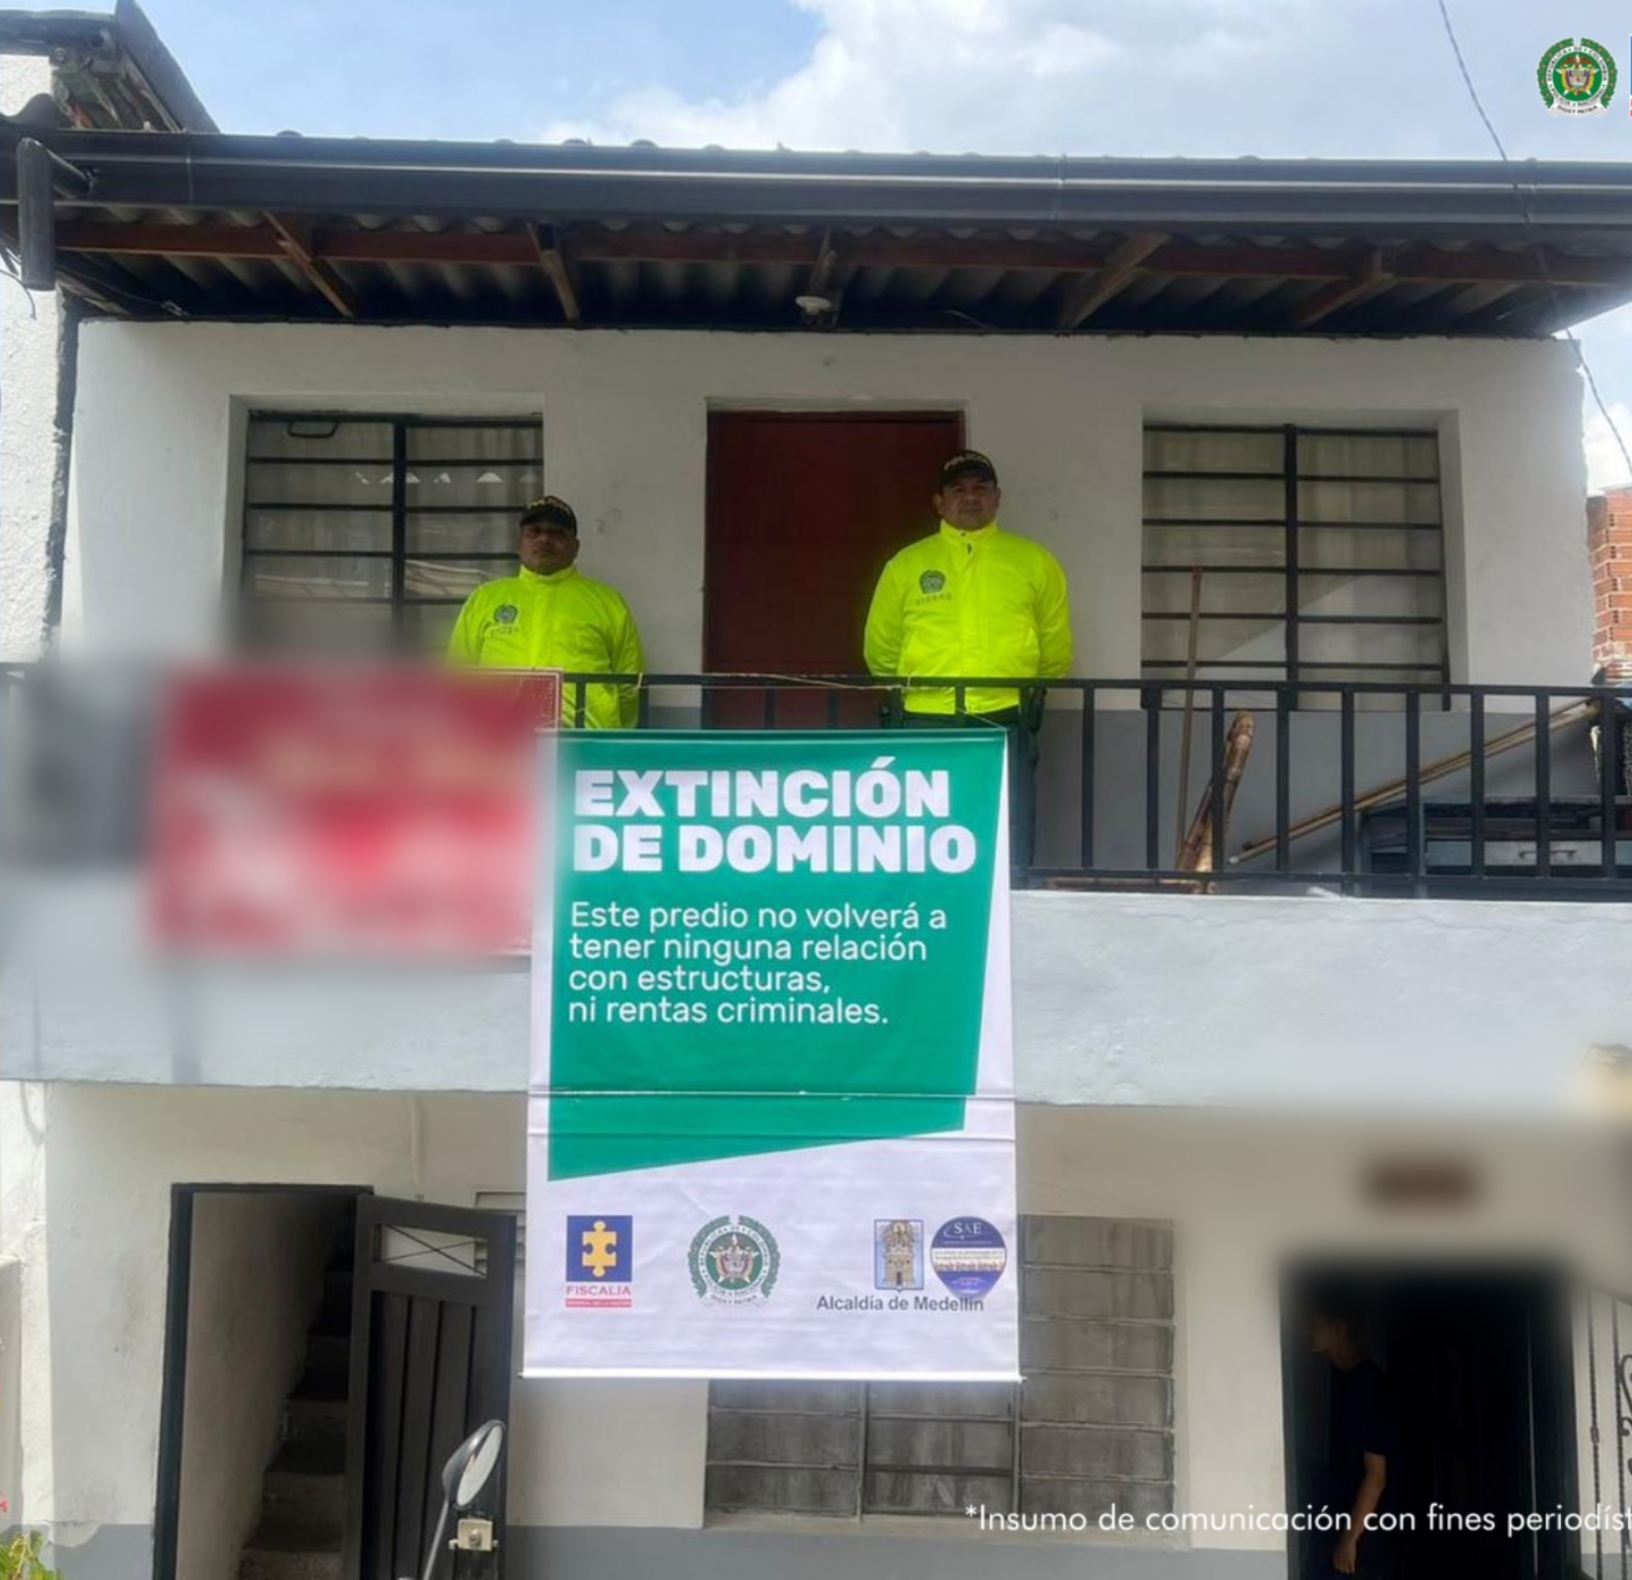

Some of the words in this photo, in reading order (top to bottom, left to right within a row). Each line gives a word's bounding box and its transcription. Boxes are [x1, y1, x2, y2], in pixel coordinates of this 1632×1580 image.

[573, 755, 951, 818] EXTINCIÓN
[573, 824, 663, 873] DE
[678, 823, 978, 874] DOMINIO
[571, 901, 640, 929] Este
[649, 902, 749, 934] predio
[758, 908, 797, 929] no
[805, 901, 920, 930] volverá
[929, 910, 947, 929] a
[569, 935, 656, 960] tener
[664, 932, 792, 967] ninguna
[802, 932, 928, 962] relación
[568, 969, 628, 992] con
[637, 965, 830, 995] estructuras,
[568, 996, 596, 1022] ni
[606, 997, 708, 1023] rentas
[717, 996, 889, 1025] criminales.
[566, 1284, 632, 1297] FISCALIA
[816, 1295, 884, 1312] Alcaldía
[888, 1295, 909, 1311] de
